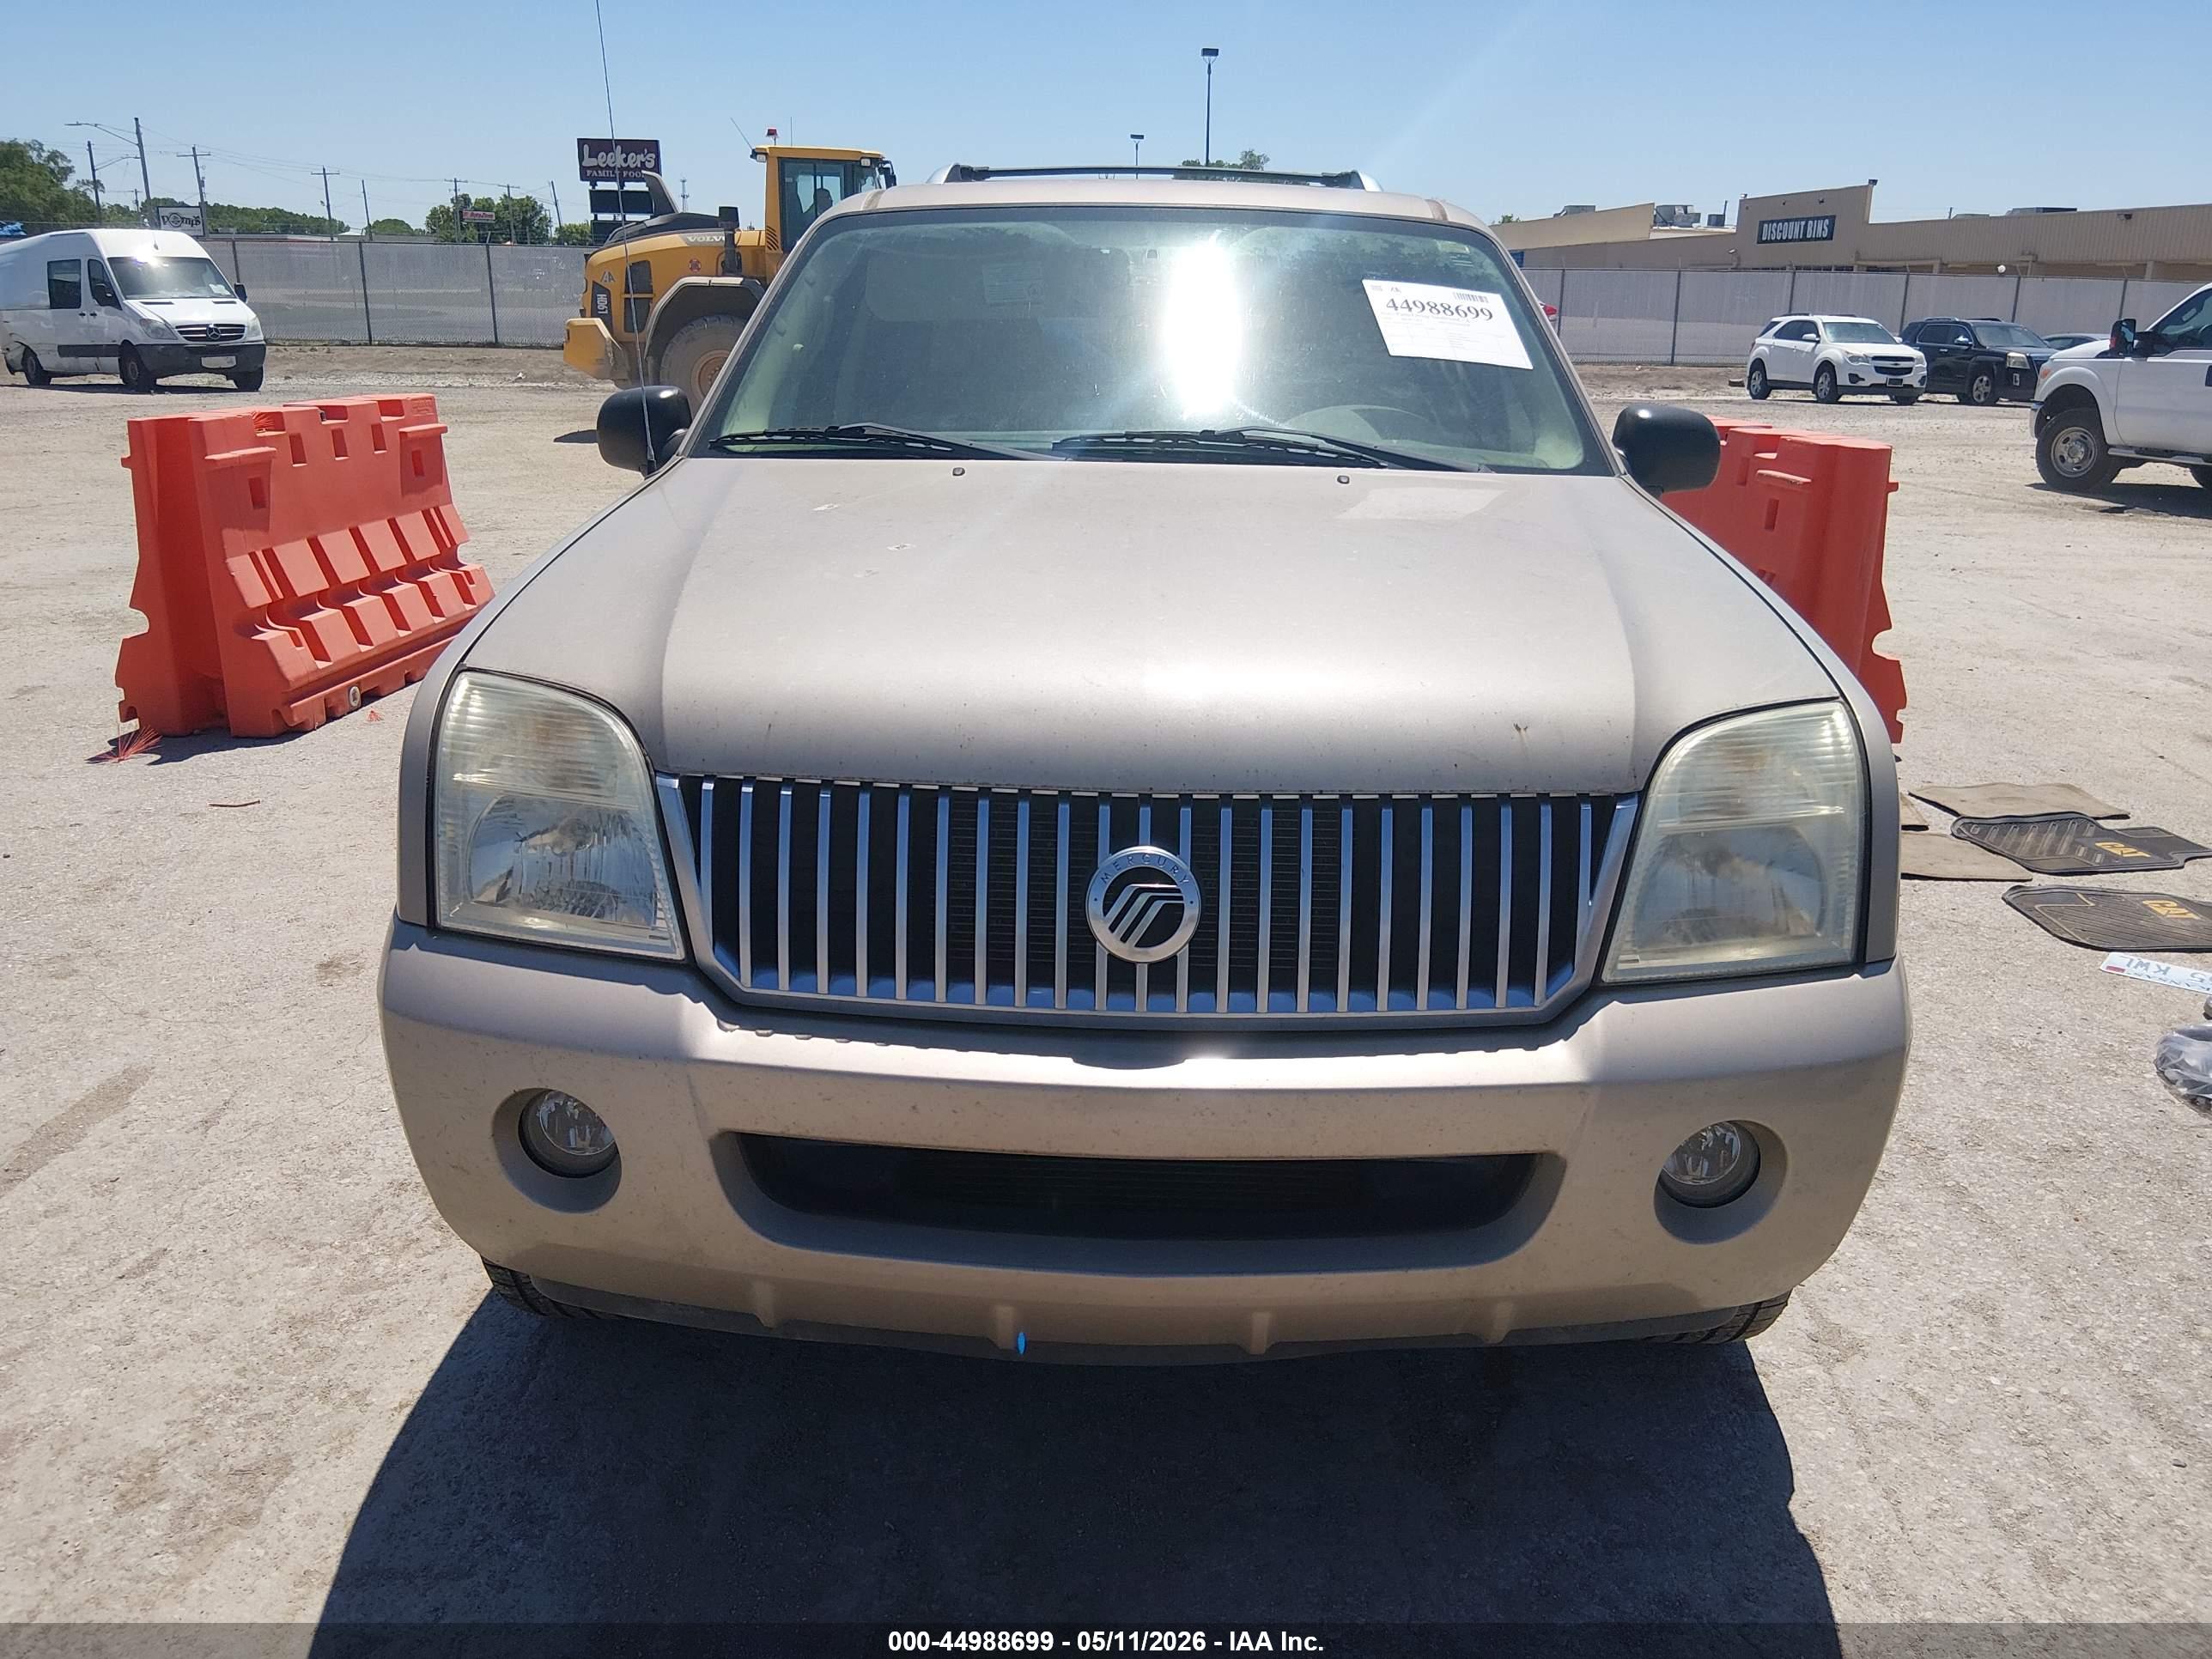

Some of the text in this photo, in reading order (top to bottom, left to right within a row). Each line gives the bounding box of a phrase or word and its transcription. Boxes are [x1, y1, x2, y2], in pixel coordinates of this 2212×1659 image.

[582, 143, 655, 168] Leeker's
[1762, 219, 1829, 240] DISCOUNT BINS
[1386, 298, 1493, 321] 44988699
[2094, 842, 2151, 858] CAT
[1100, 853, 1190, 885] MERCURY
[2142, 899, 2201, 921] CAT
